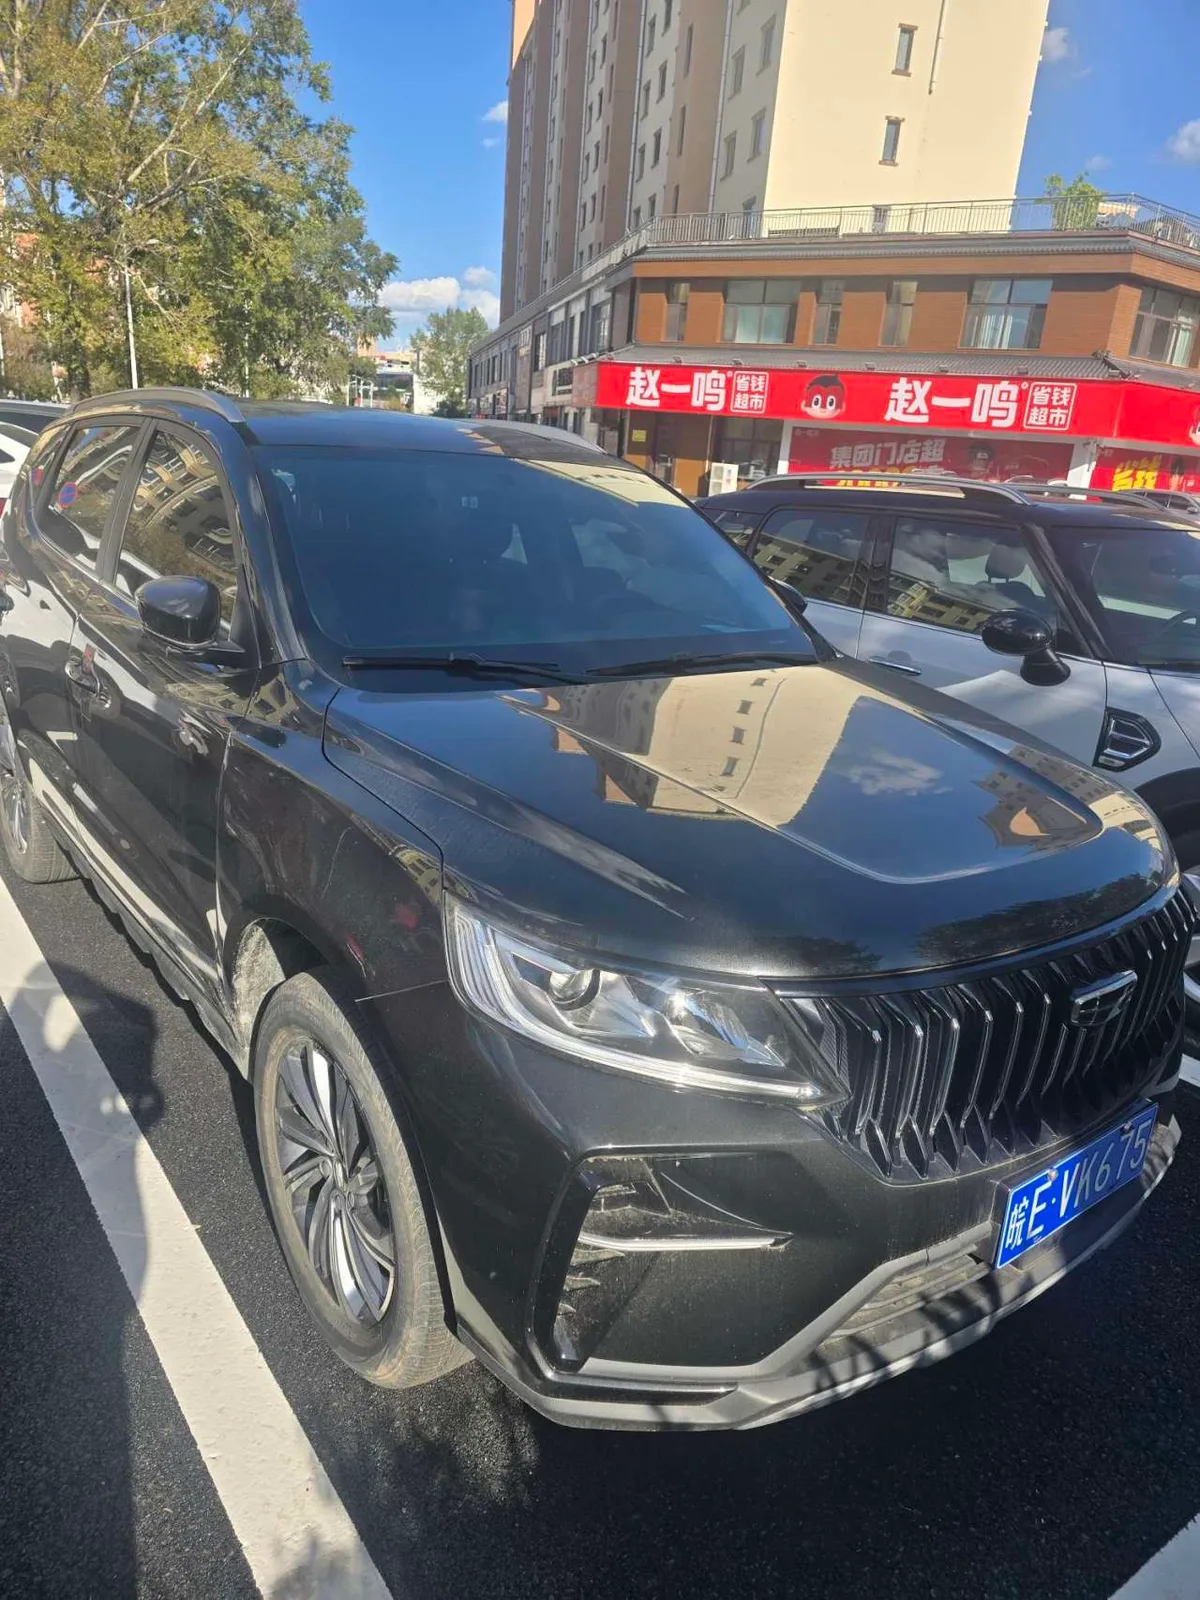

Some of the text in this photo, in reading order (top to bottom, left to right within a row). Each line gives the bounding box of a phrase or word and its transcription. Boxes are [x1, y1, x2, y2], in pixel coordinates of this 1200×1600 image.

[626, 366, 726, 412] 赵一鸣
[735, 373, 766, 391] 省钱
[733, 393, 764, 410] 超市
[884, 377, 1020, 428] 赵一鸣
[1031, 386, 1072, 406] 省钱
[1027, 407, 1069, 426] 超市
[829, 438, 946, 468] 集团门店超
